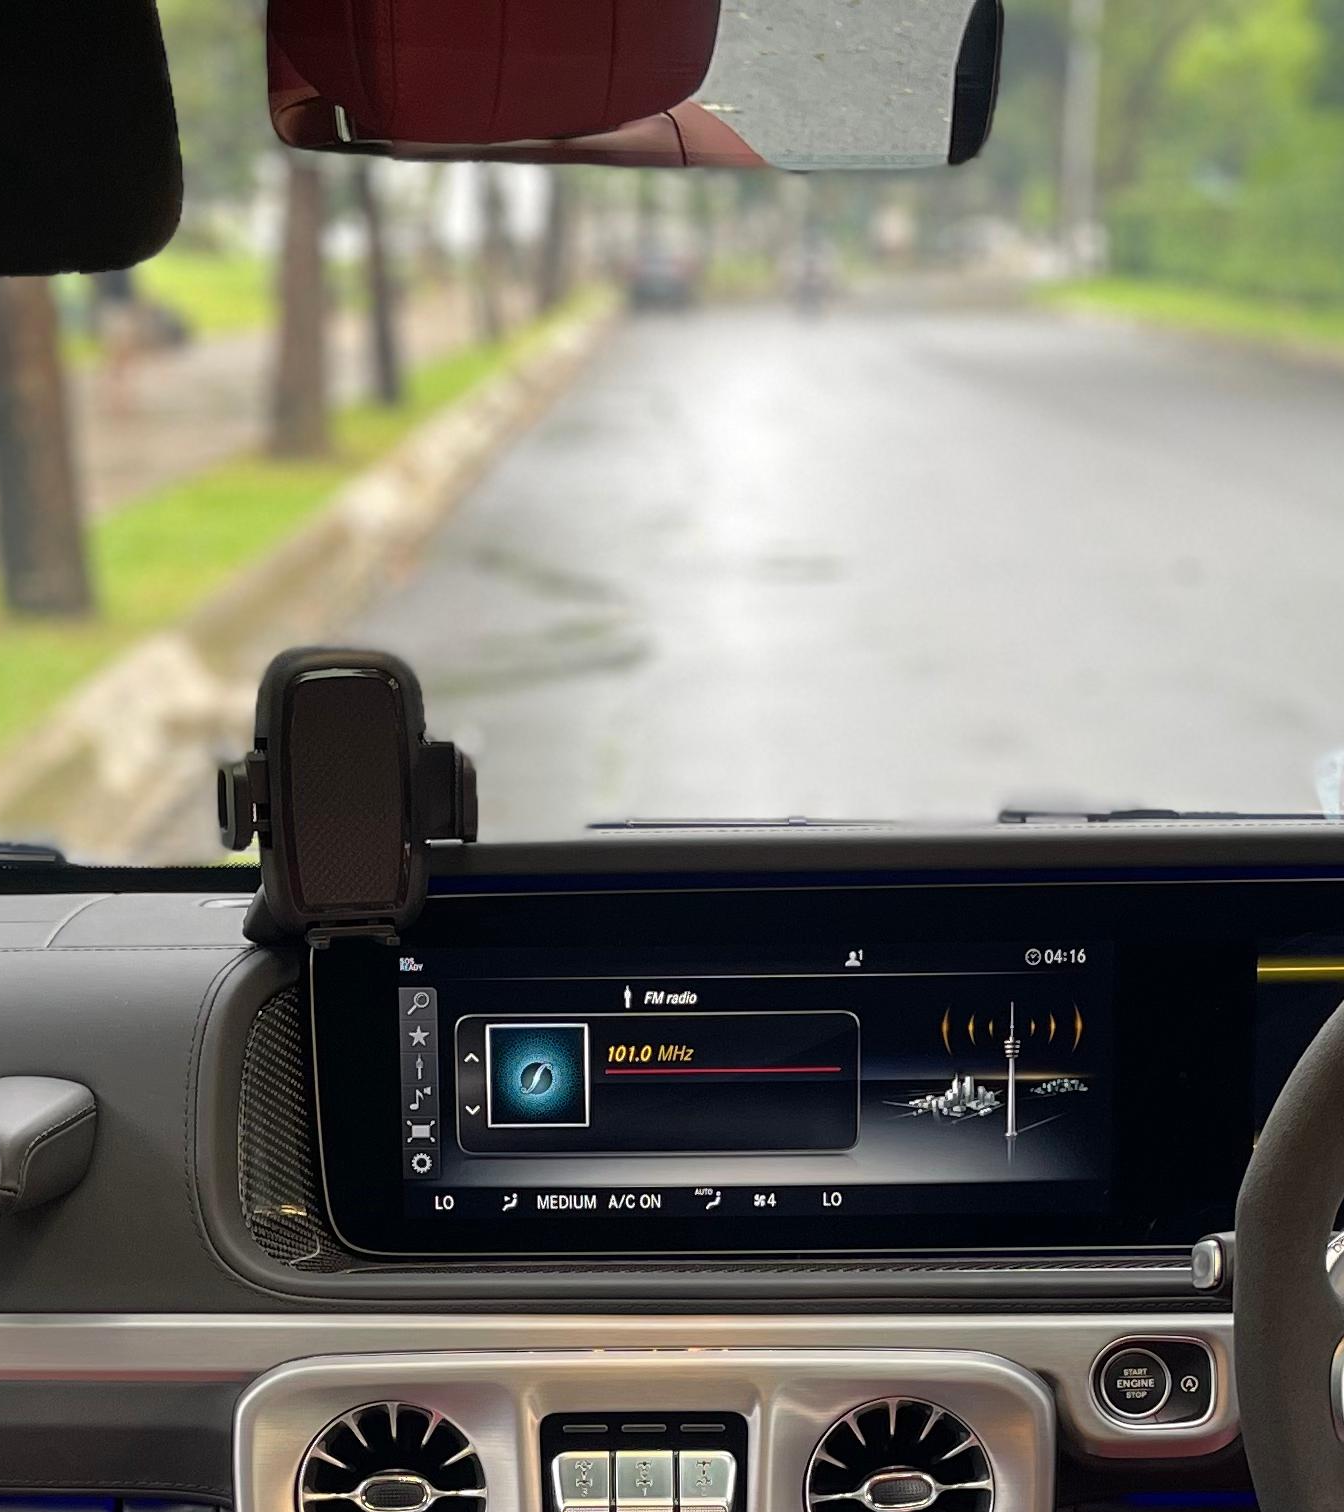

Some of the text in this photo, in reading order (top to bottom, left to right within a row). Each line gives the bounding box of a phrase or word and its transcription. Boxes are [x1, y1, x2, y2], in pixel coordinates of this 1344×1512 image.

[1044, 948, 1087, 964] 04:16
[399, 964, 424, 972] READY
[644, 990, 698, 1005] FM radio
[607, 1044, 694, 1062] 101.0 MHz
[695, 1188, 714, 1196] AUTO
[822, 1192, 842, 1207] LO
[434, 1195, 454, 1210] LO
[537, 1194, 597, 1210] MEDIUM
[608, 1194, 662, 1209] A/C ON
[767, 1192, 777, 1208] 4
[1123, 1368, 1148, 1376] START
[1116, 1378, 1155, 1389] ENGINE
[1126, 1391, 1148, 1399] STOP
